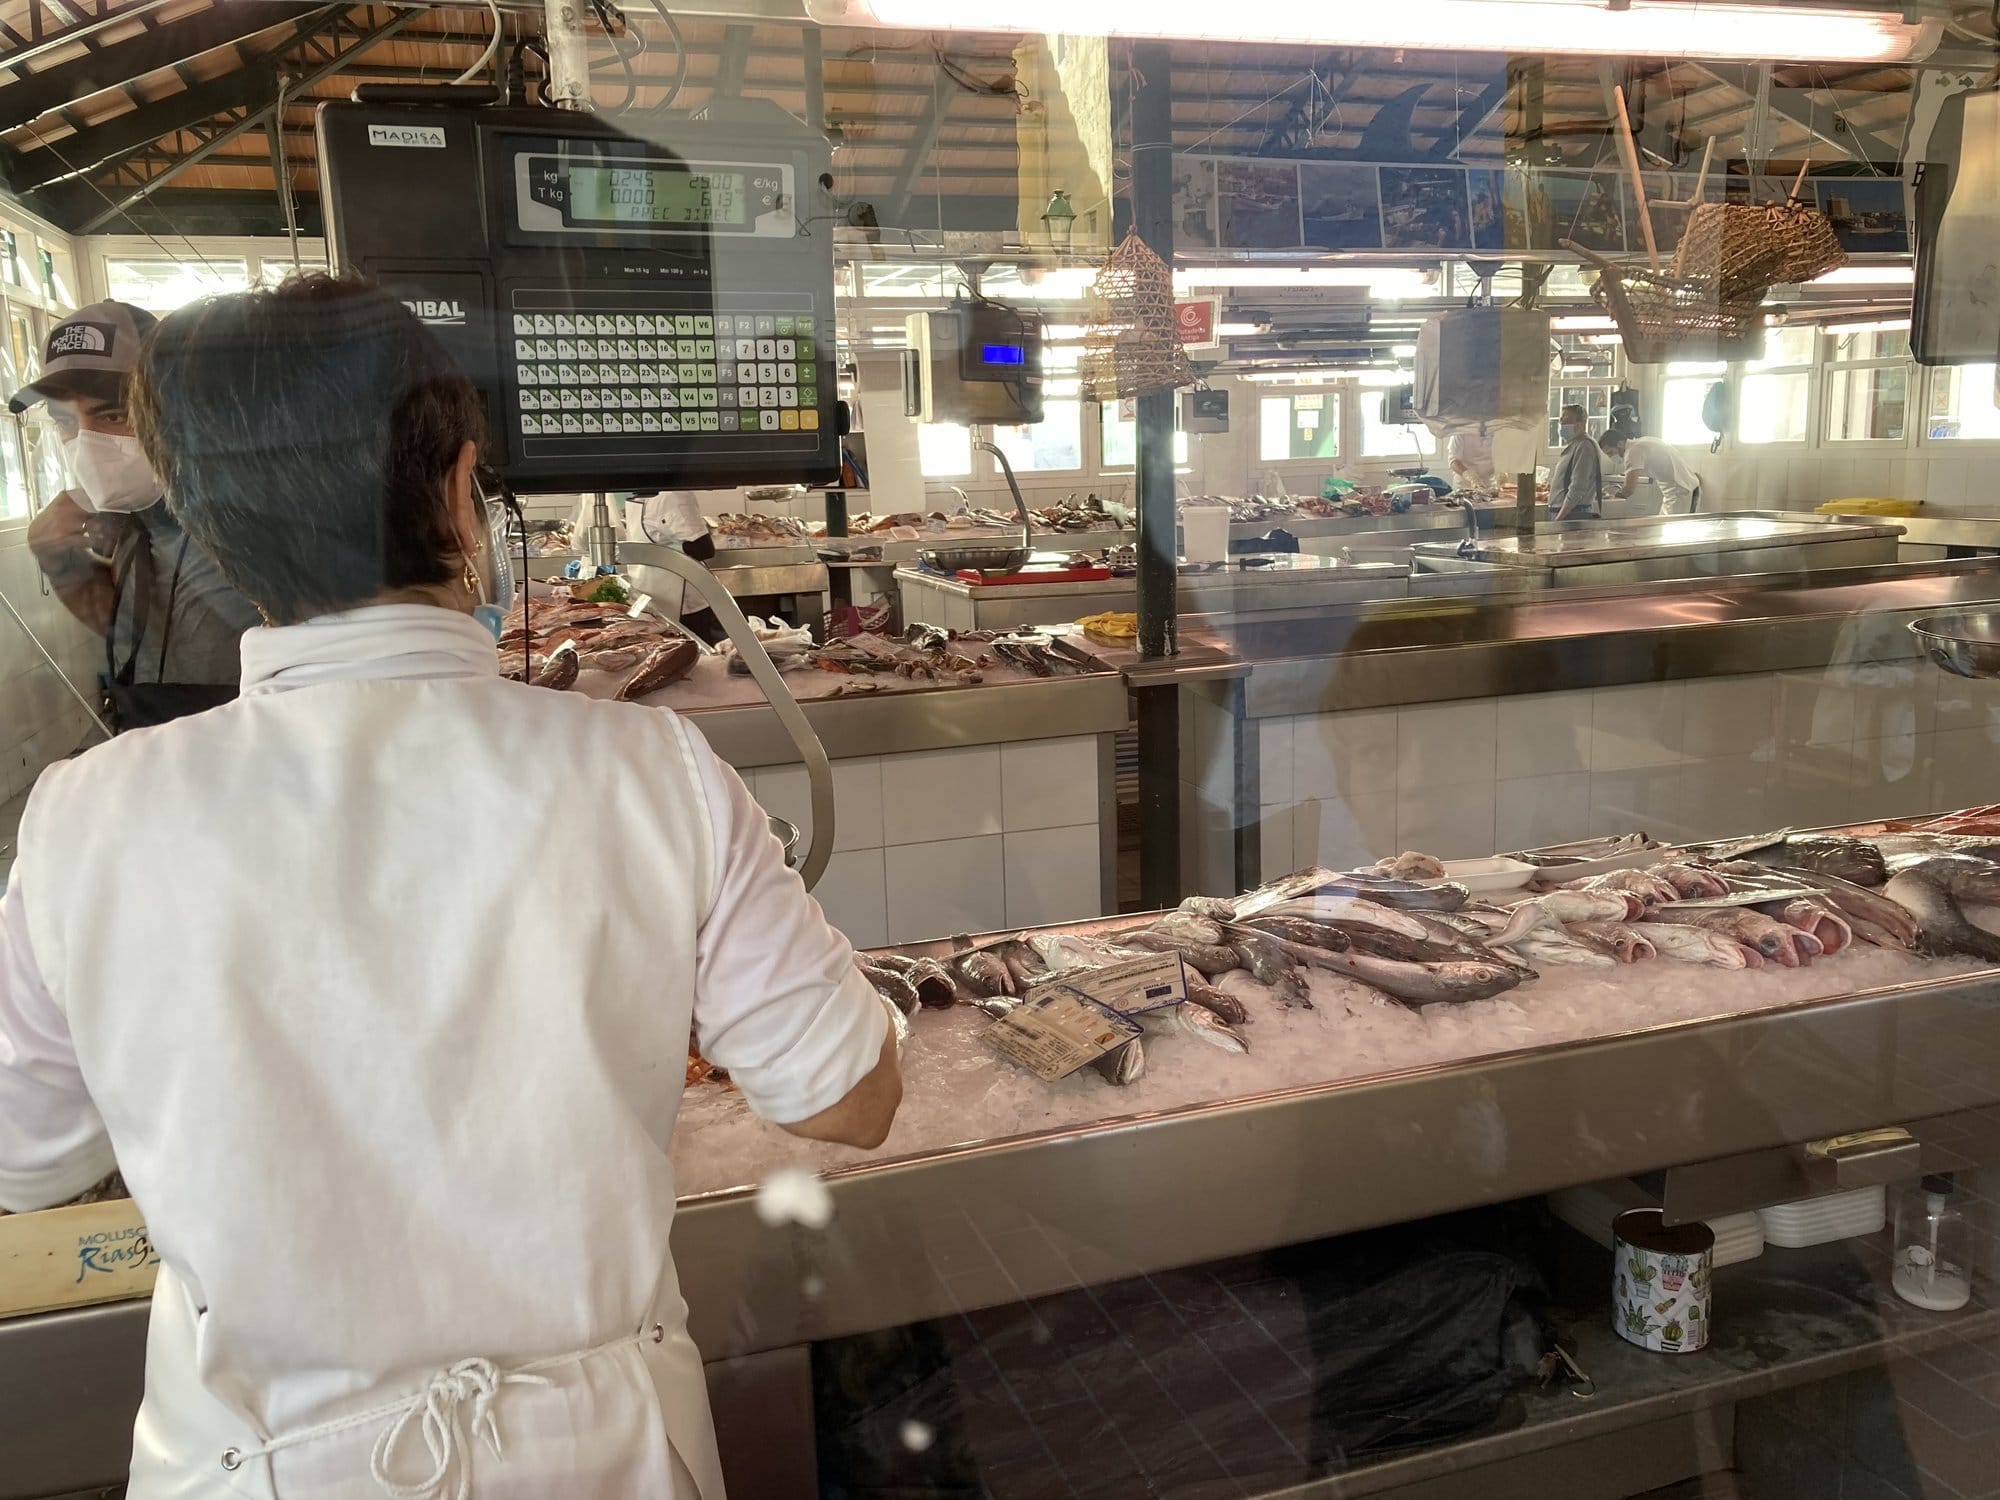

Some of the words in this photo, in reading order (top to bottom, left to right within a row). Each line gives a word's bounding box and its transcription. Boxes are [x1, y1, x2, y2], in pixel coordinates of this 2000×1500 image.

[373, 130, 441, 141] MADISA
[544, 170, 558, 184] kg
[754, 177, 778, 192] €/kg
[538, 187, 546, 199] T
[550, 187, 563, 202] kg
[762, 195, 771, 206] €
[65, 325, 86, 335] THE
[52, 333, 83, 349] NORTH
[57, 341, 82, 353] FACE
